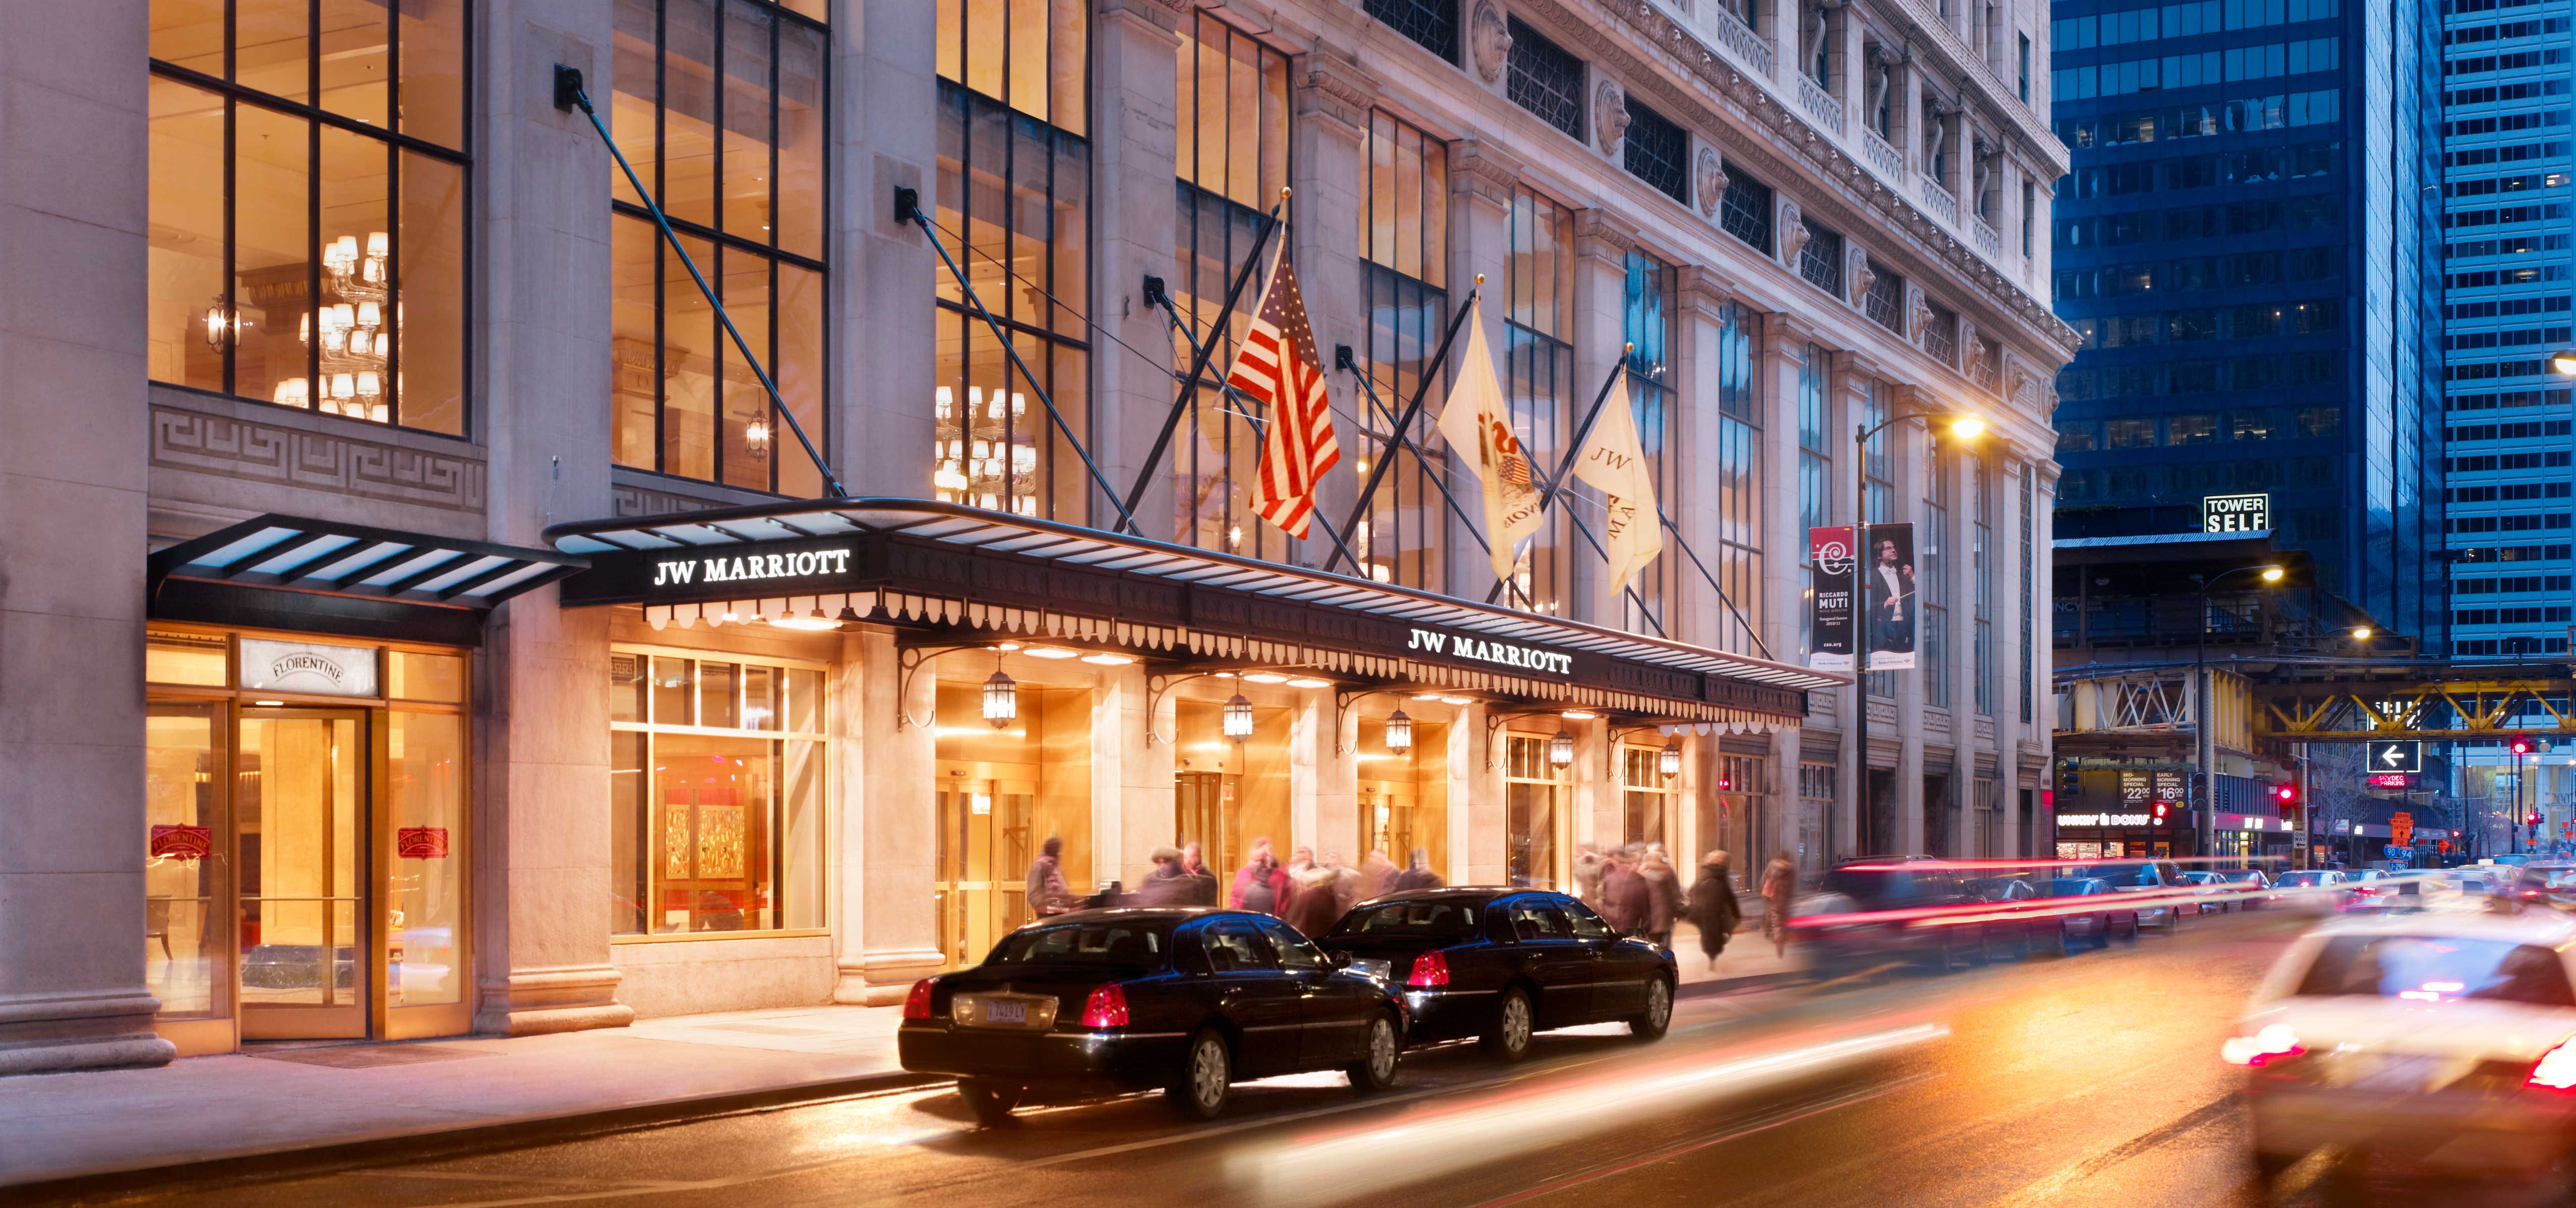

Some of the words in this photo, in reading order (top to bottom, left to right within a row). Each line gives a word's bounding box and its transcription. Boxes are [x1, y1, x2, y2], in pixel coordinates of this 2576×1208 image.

[1591, 447, 1632, 470] JW
[2208, 498, 2263, 512] TOWER
[2208, 513, 2264, 533] SELF
[655, 560, 697, 585] JW
[703, 549, 850, 582] MARRIOTT
[1819, 598, 1848, 609] MUTI
[2052, 602, 2081, 612] INCY
[1408, 629, 1446, 653] JW
[1453, 636, 1571, 674] MARRIOTT
[273, 657, 343, 683] FLORENTINE
[2058, 814, 2099, 826] UNKIN'
[2388, 848, 2395, 856] 90
[2402, 850, 2412, 858] 94
